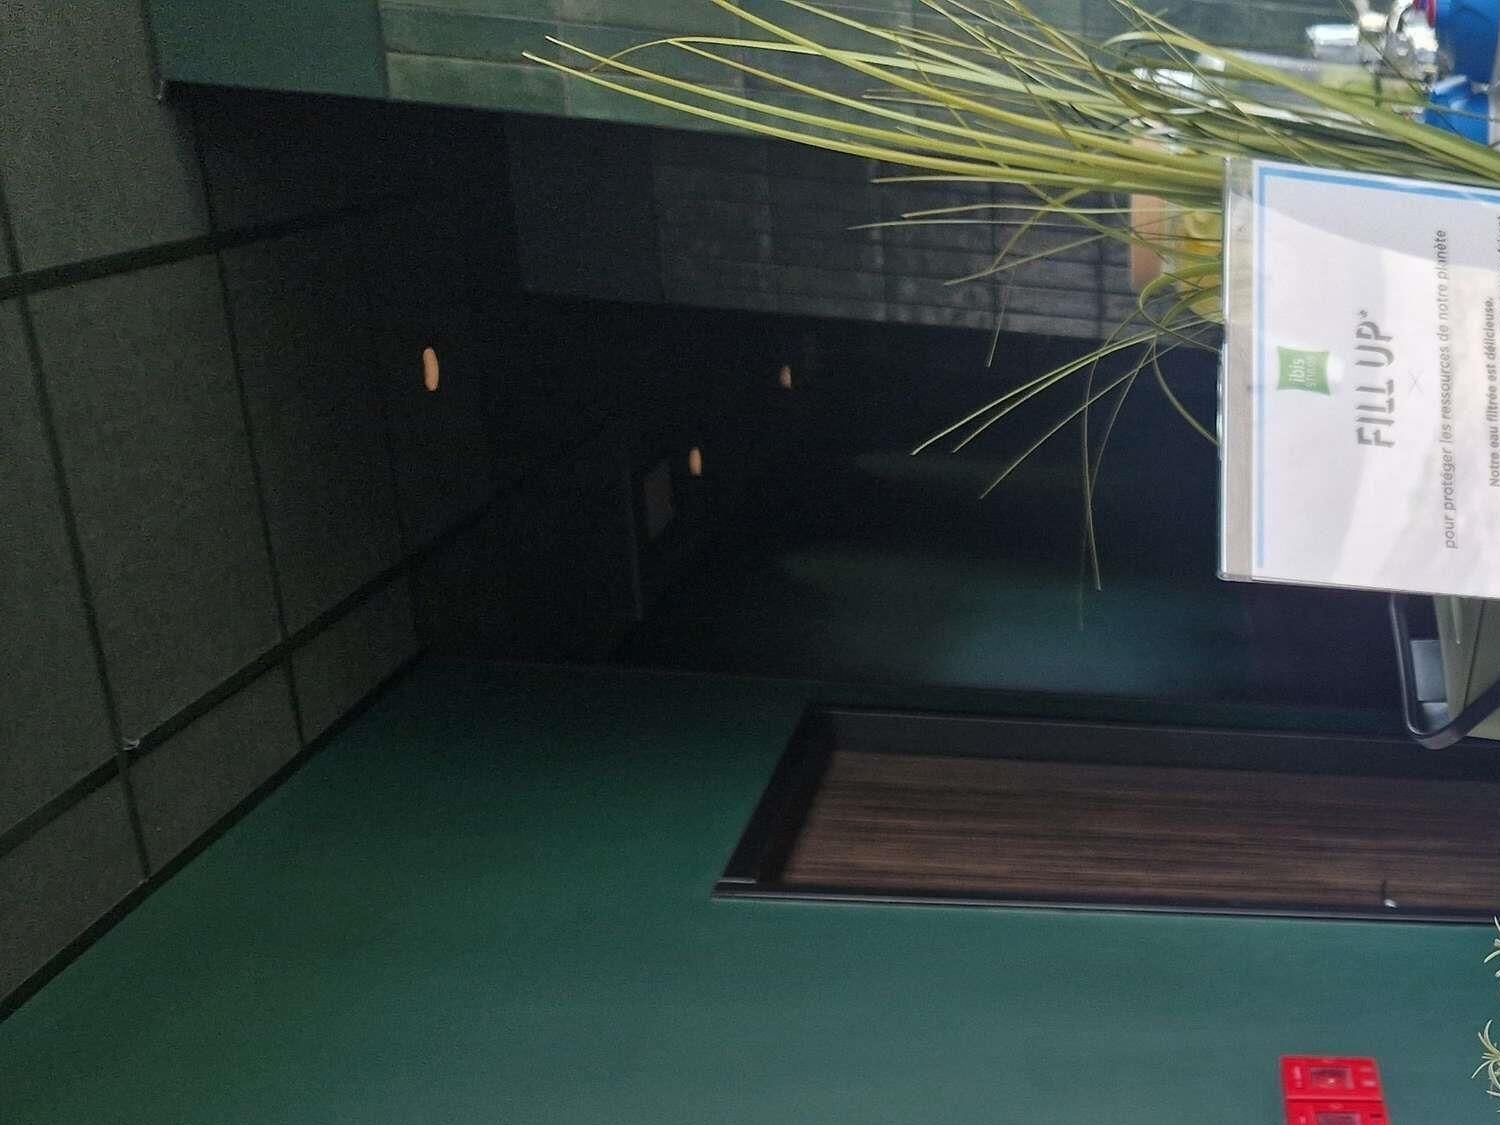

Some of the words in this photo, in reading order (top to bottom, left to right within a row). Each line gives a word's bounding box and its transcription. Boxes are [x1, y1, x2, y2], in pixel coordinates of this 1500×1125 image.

[1432, 230, 1449, 281] planète
[1435, 285, 1451, 322] notre
[1435, 325, 1451, 343] de
[1483, 298, 1496, 361] délicieuse.
[1288, 358, 1306, 384] ibis
[1439, 346, 1453, 421] ressources
[1485, 364, 1497, 382] est
[1354, 379, 1395, 449] FILL
[1485, 386, 1498, 422] filtrée
[1438, 424, 1454, 444] les
[1488, 427, 1499, 449] eau
[1439, 448, 1456, 512] protéger
[1488, 452, 1500, 488] Notre
[1443, 515, 1458, 550] pour
